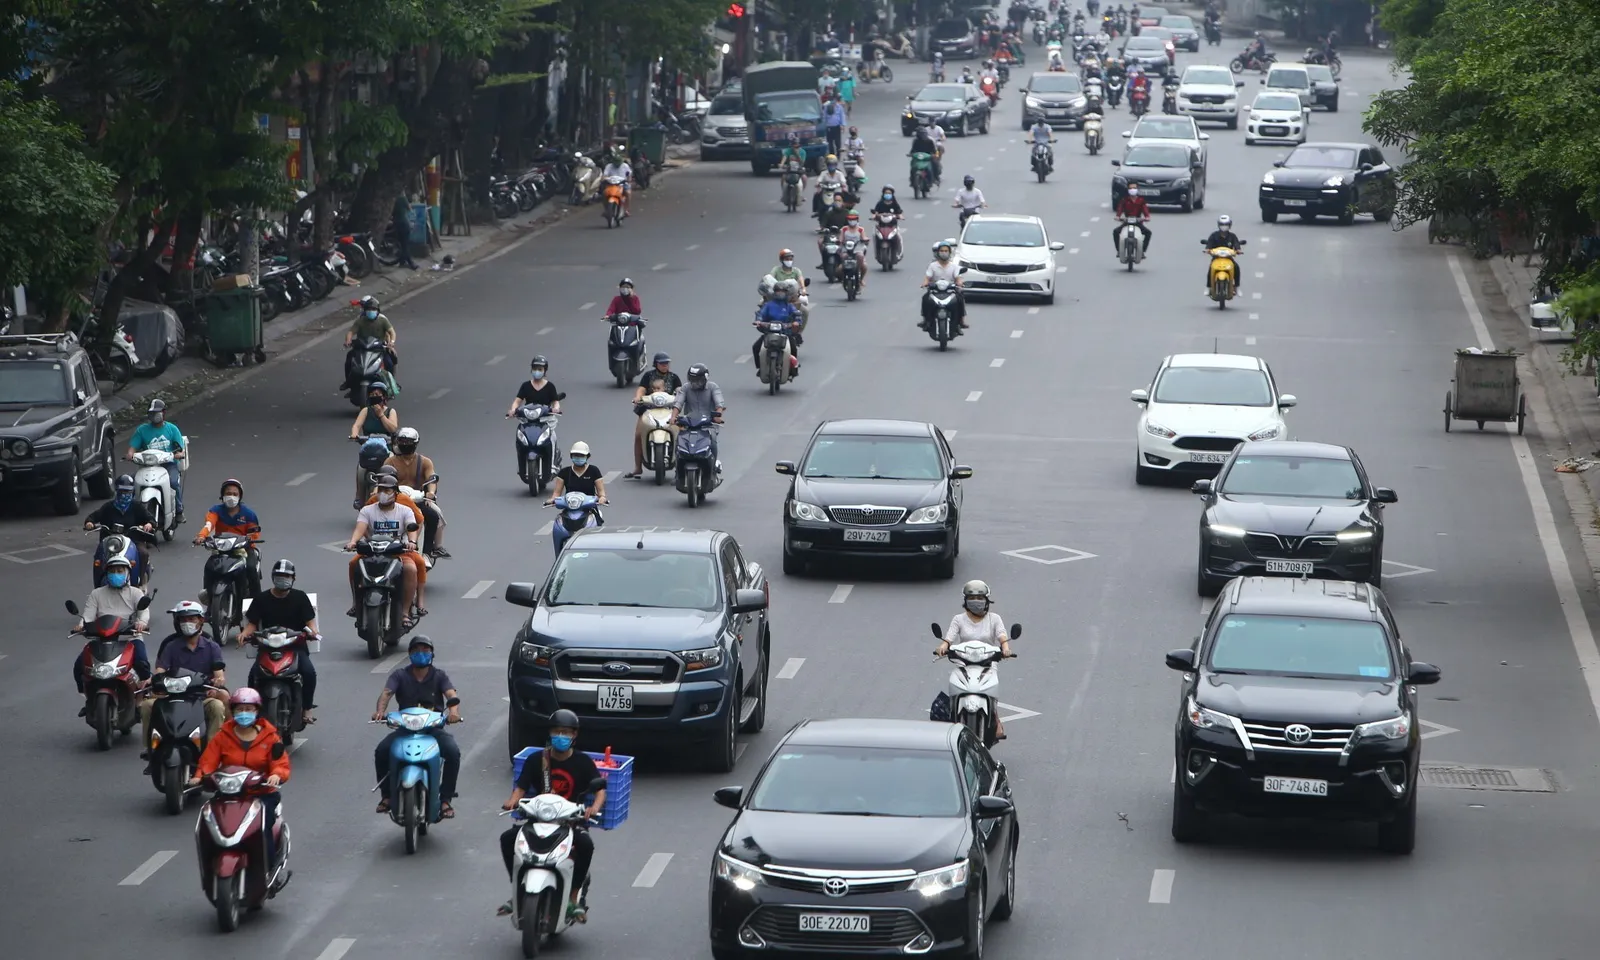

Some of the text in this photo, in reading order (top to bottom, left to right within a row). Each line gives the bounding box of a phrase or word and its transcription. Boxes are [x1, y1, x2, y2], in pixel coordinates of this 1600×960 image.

[847, 531, 887, 542] 29V-7427
[1268, 561, 1312, 572] 51H-709.67
[608, 686, 625, 698] 14C
[600, 698, 632, 709] 147.59
[1266, 779, 1326, 794] 30F-748.46
[801, 916, 868, 931] 30E-220.70
